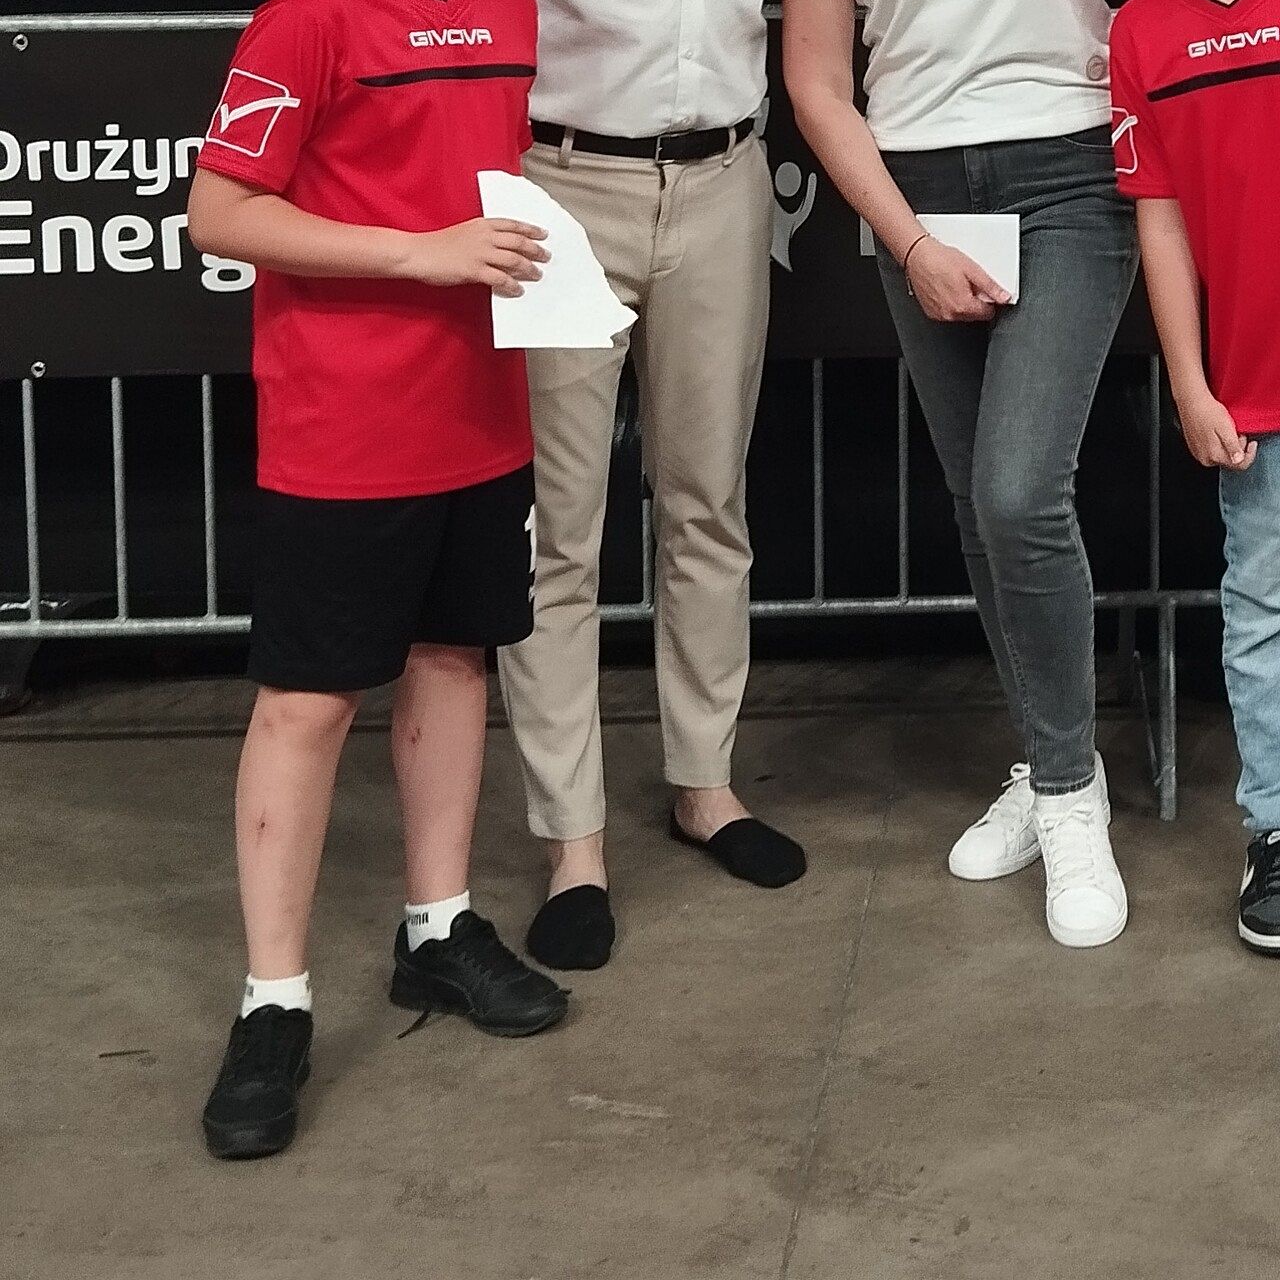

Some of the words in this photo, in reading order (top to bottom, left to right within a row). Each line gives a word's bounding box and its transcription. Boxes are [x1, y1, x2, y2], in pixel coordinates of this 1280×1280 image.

[408, 28, 494, 48] GIVOVA
[1187, 26, 1280, 59] GIVOVA
[0, 124, 206, 196] rużyn
